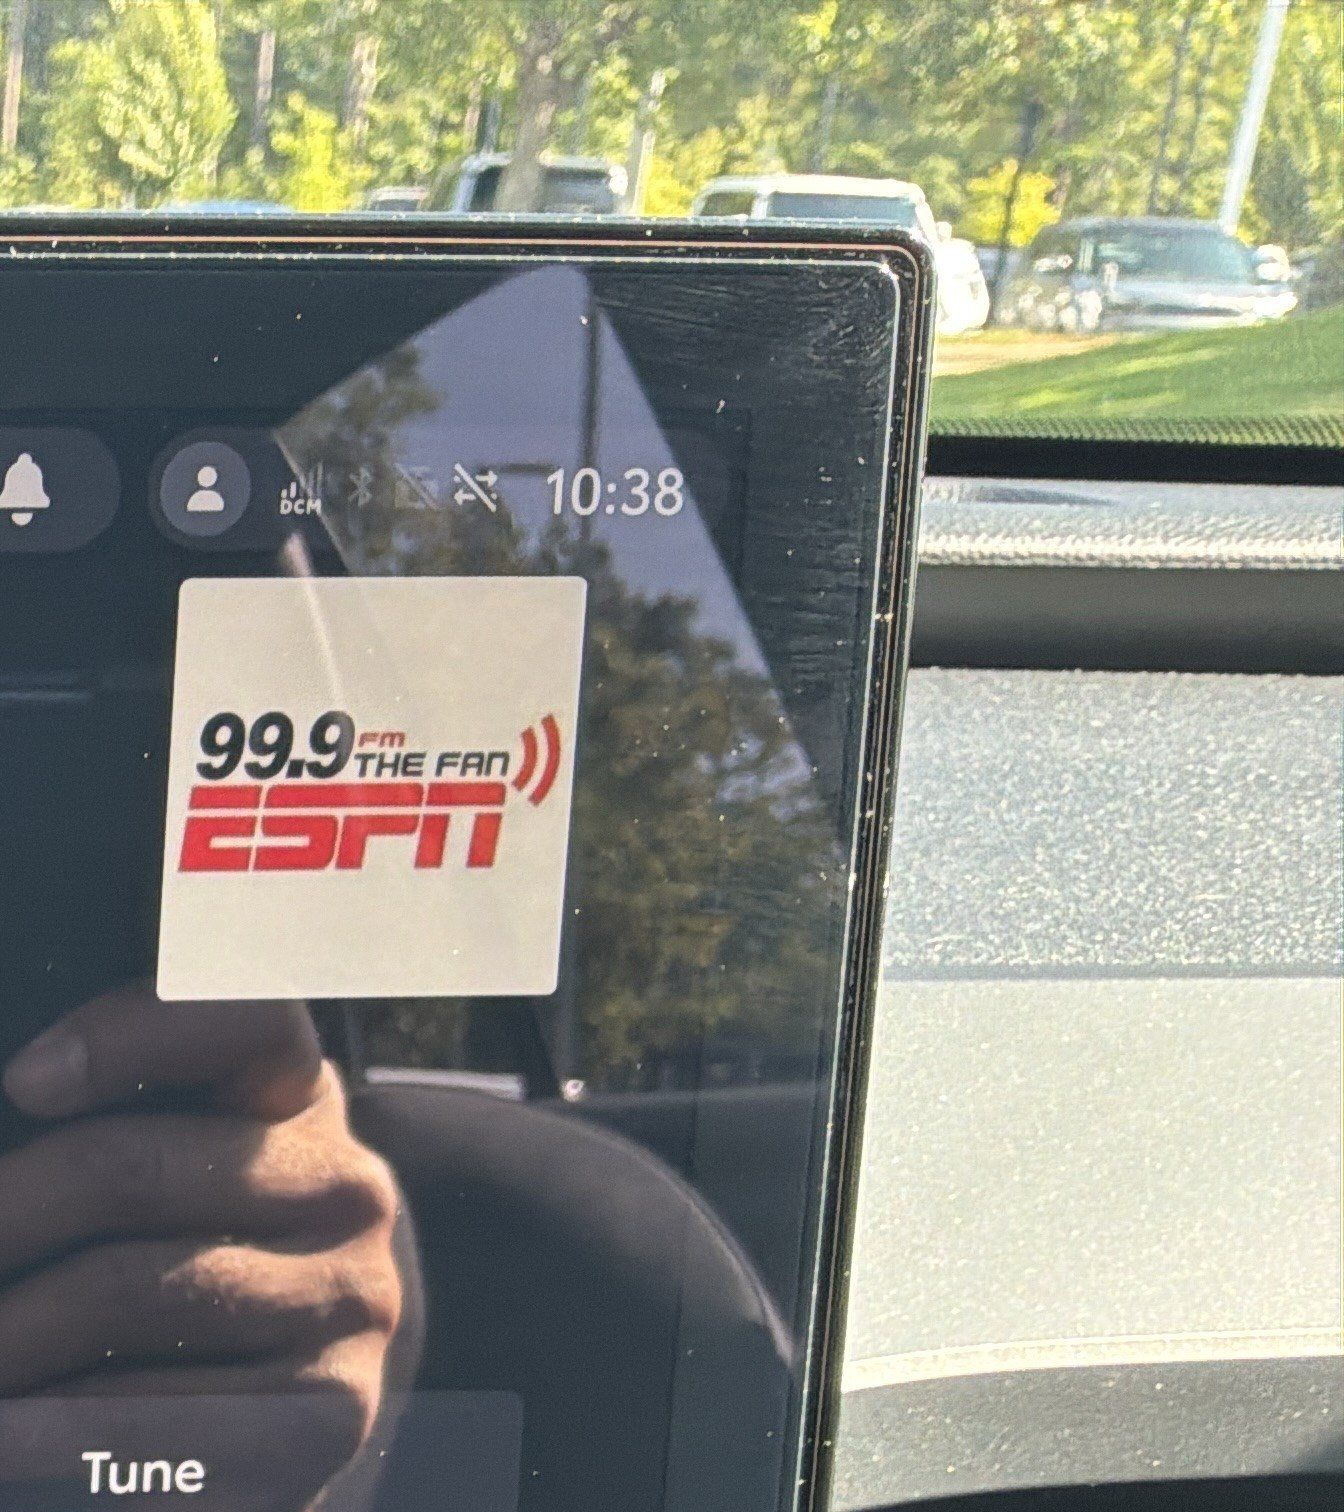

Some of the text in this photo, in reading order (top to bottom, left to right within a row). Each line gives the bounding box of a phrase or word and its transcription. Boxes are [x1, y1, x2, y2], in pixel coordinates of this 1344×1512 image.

[279, 498, 323, 516] DCM
[546, 467, 684, 517] 10:38
[196, 711, 355, 780] 99.9
[357, 730, 406, 748] FM
[355, 750, 510, 777] THE FAN
[177, 781, 507, 872] ESPN
[81, 1451, 205, 1495] Tune
